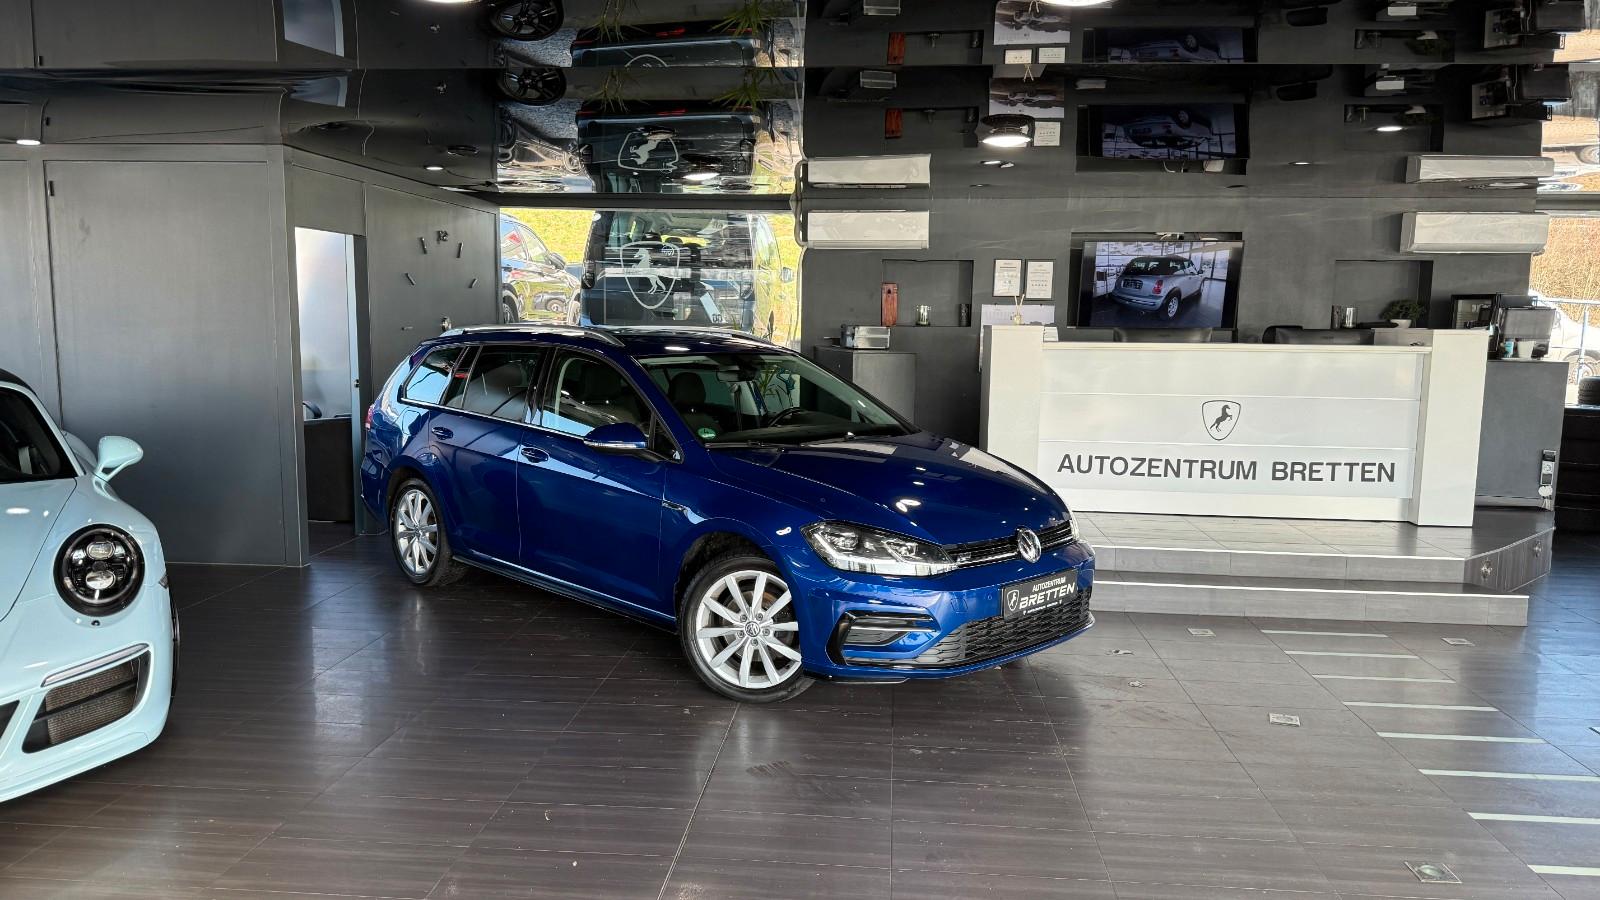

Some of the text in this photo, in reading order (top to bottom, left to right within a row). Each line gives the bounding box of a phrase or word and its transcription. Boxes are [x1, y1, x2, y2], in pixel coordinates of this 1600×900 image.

[1057, 453, 1395, 482] AUTOZENTRUM BRETTEN
[1019, 582, 1075, 609] BRETTEN
[1032, 576, 1066, 592] AUTOZENTRUM
